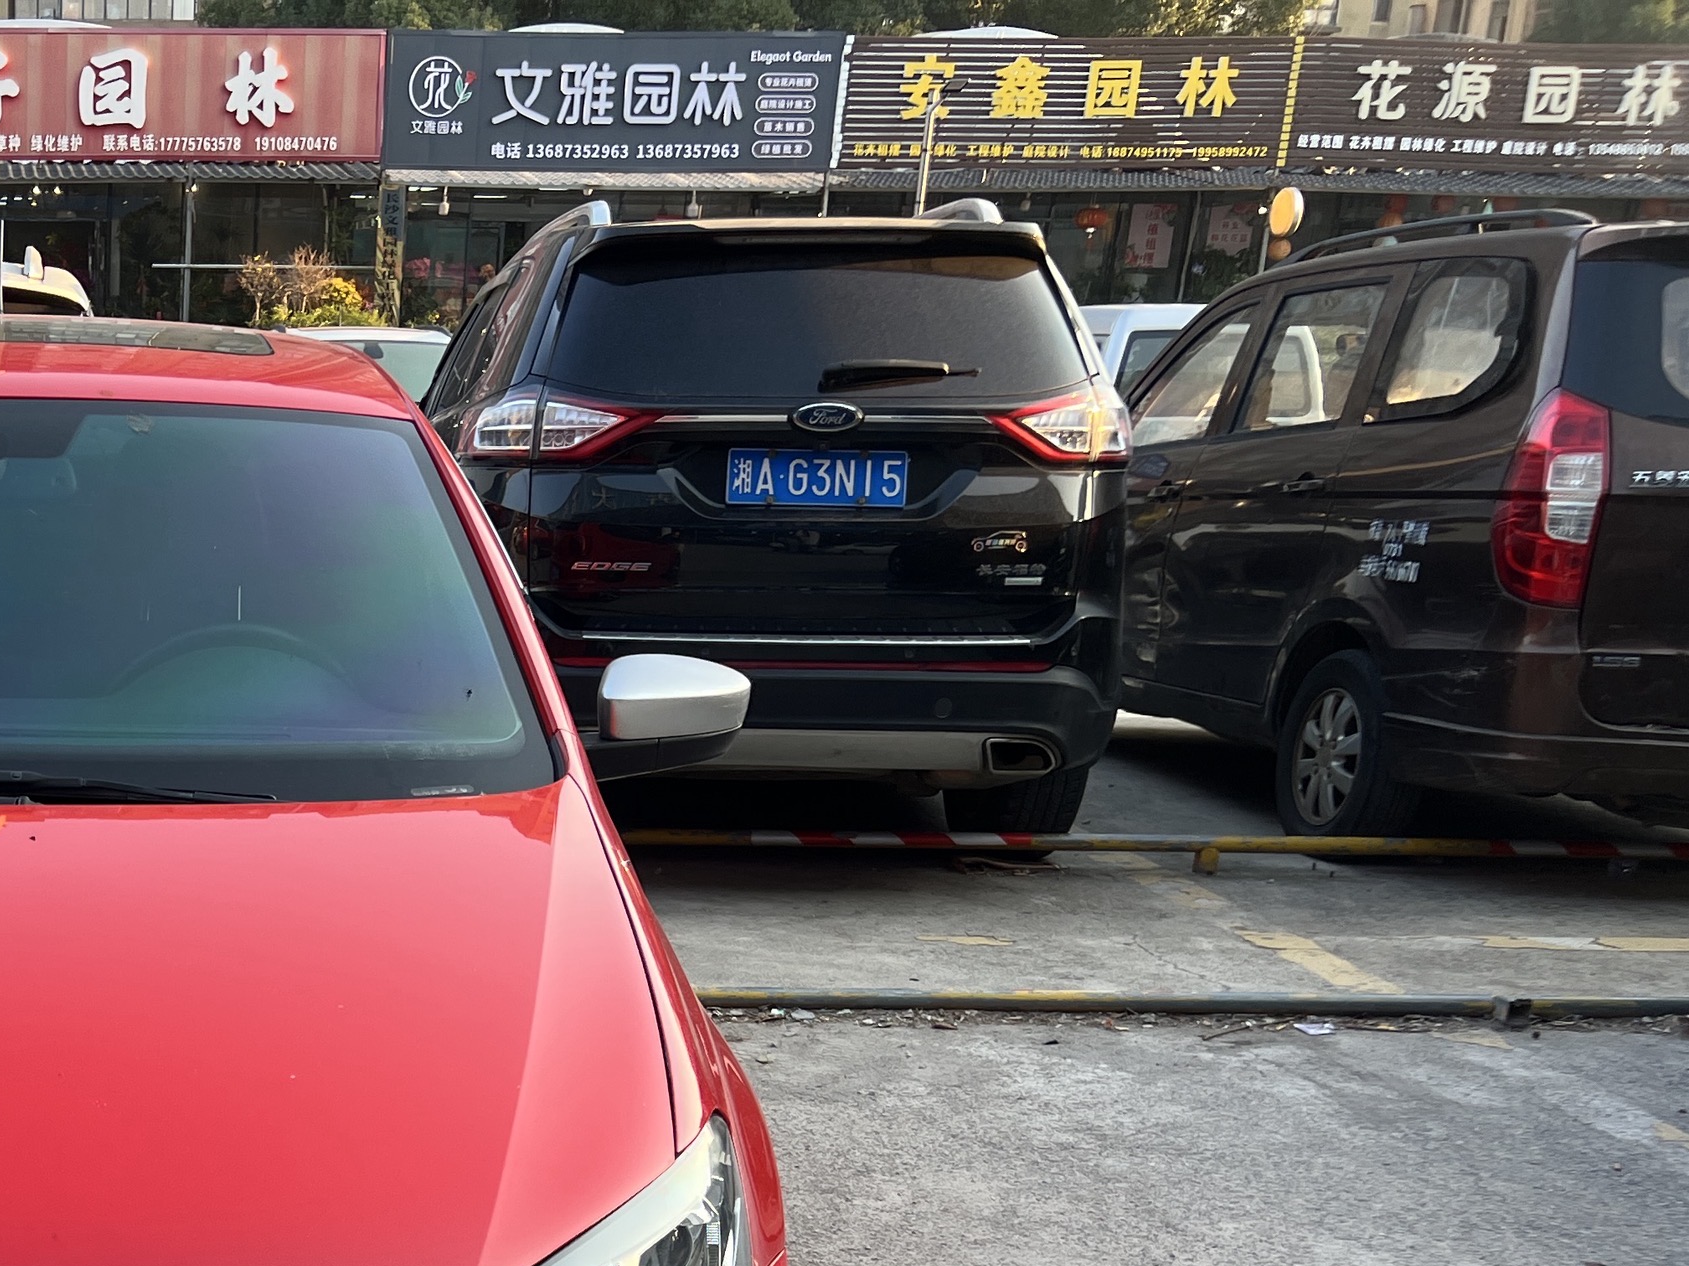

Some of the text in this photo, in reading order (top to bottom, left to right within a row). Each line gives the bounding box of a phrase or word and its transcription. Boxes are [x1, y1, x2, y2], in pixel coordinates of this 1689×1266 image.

[793, 50, 832, 62] Garden
[491, 60, 746, 126] 文雅园林
[1351, 60, 1682, 126] 花源园林
[410, 120, 463, 134] 文雅园林
[254, 136, 338, 152] 19108470476
[491, 142, 740, 159] 电话 13687352963 13687357963
[909, 144, 957, 157] 园绿化
[809, 408, 846, 425] Ford
[571, 562, 652, 571] EDGE
